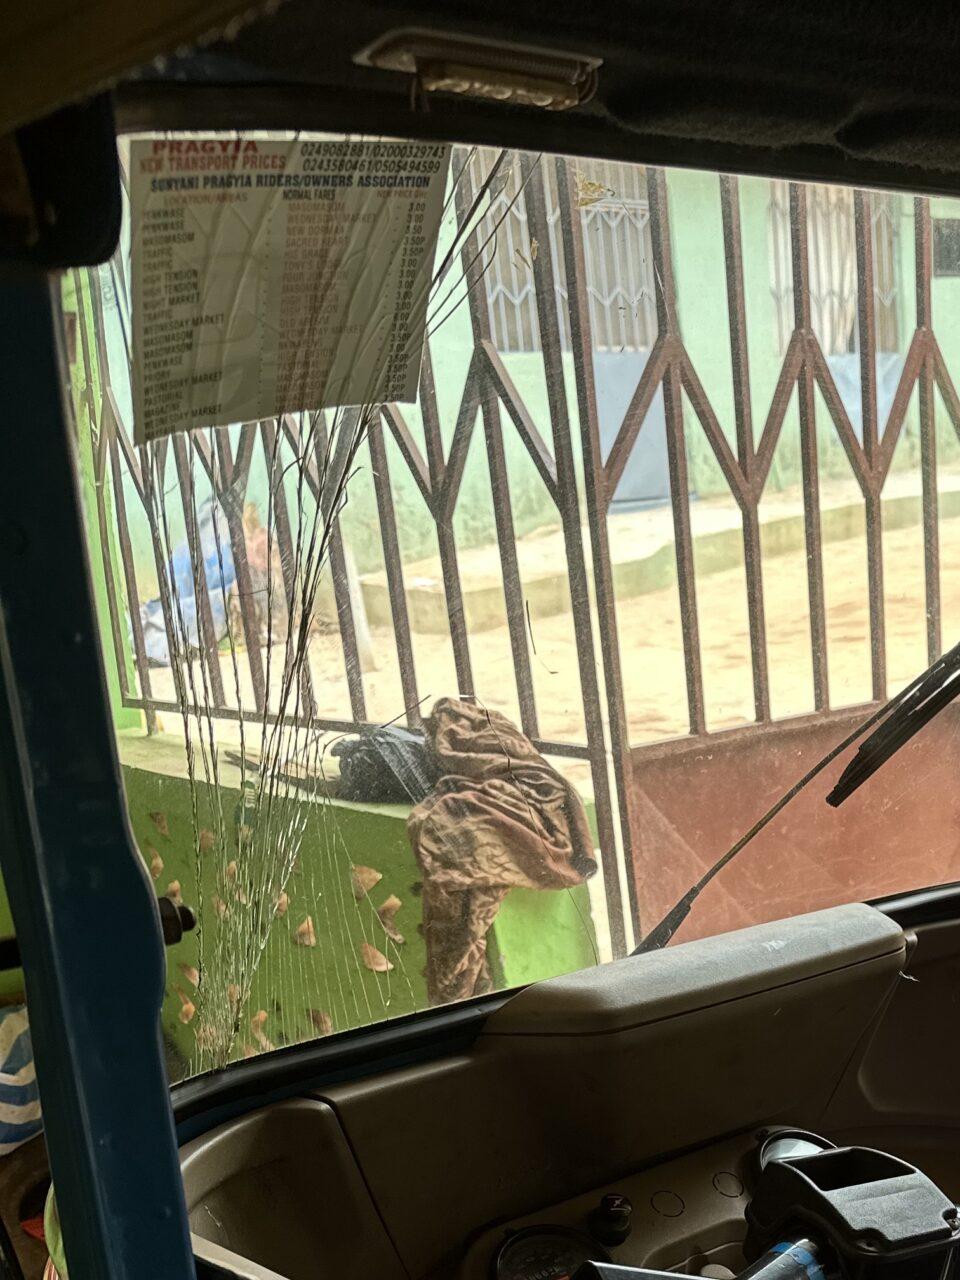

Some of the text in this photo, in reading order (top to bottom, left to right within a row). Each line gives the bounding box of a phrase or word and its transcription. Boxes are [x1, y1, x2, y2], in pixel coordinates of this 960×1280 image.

[152, 140, 258, 155] PRAGYIA
[168, 155, 238, 171] TRANSPORT
[243, 154, 287, 169] PRICES
[151, 173, 431, 193] SUNYANI PRAGYIA RIDERS/OWNERS ASSOCIATION
